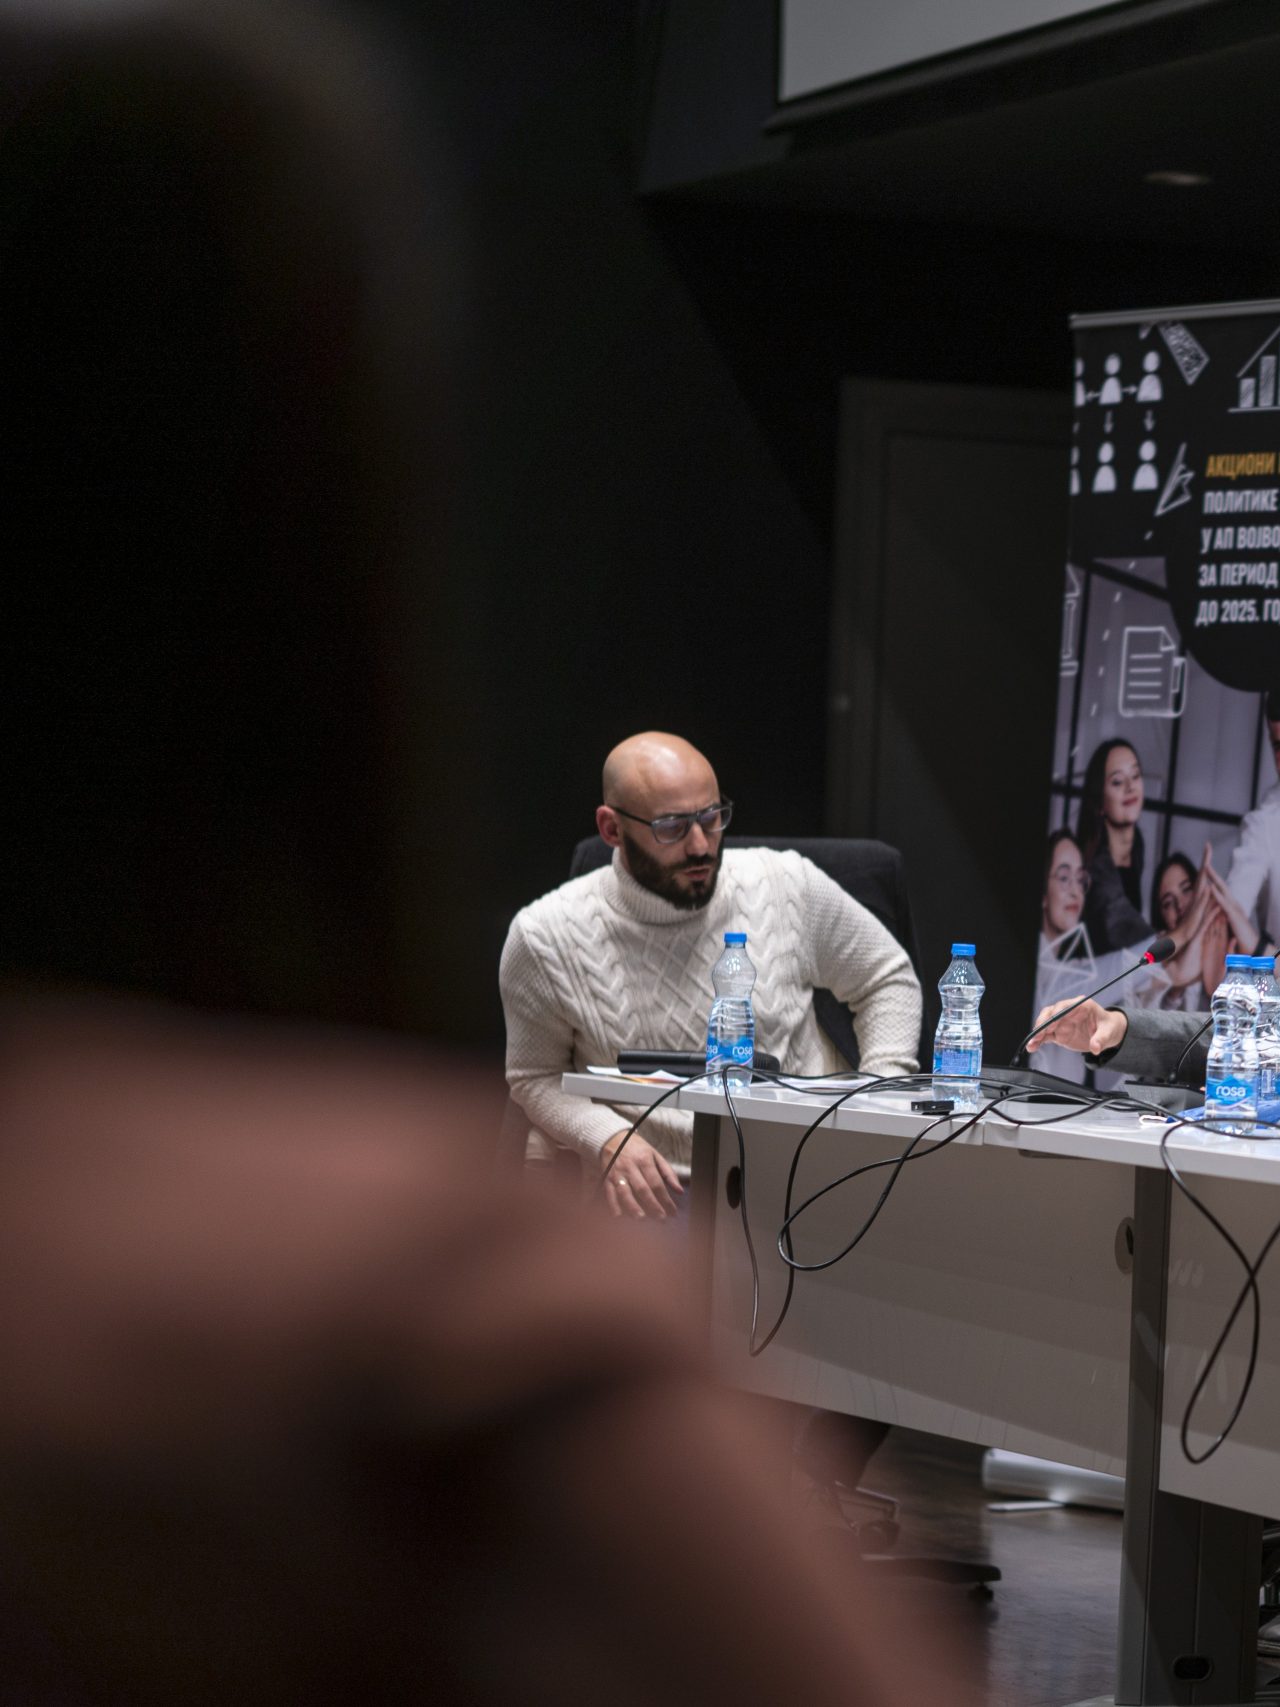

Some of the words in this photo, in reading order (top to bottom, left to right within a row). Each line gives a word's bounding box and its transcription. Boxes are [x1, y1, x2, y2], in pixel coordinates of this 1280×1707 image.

[1206, 453, 1275, 479] АКЦИОНИ
[1203, 489, 1279, 514] ПОЛИТИКЕ
[1200, 528, 1212, 554] У
[1213, 526, 1235, 550] АП
[1199, 564, 1217, 587] ЗА
[1220, 562, 1279, 588] ПЕРИОД
[1195, 600, 1219, 626] ДО
[1220, 599, 1259, 623] 2025.
[732, 1046, 753, 1055] rosa
[1215, 1085, 1246, 1097] rosa
